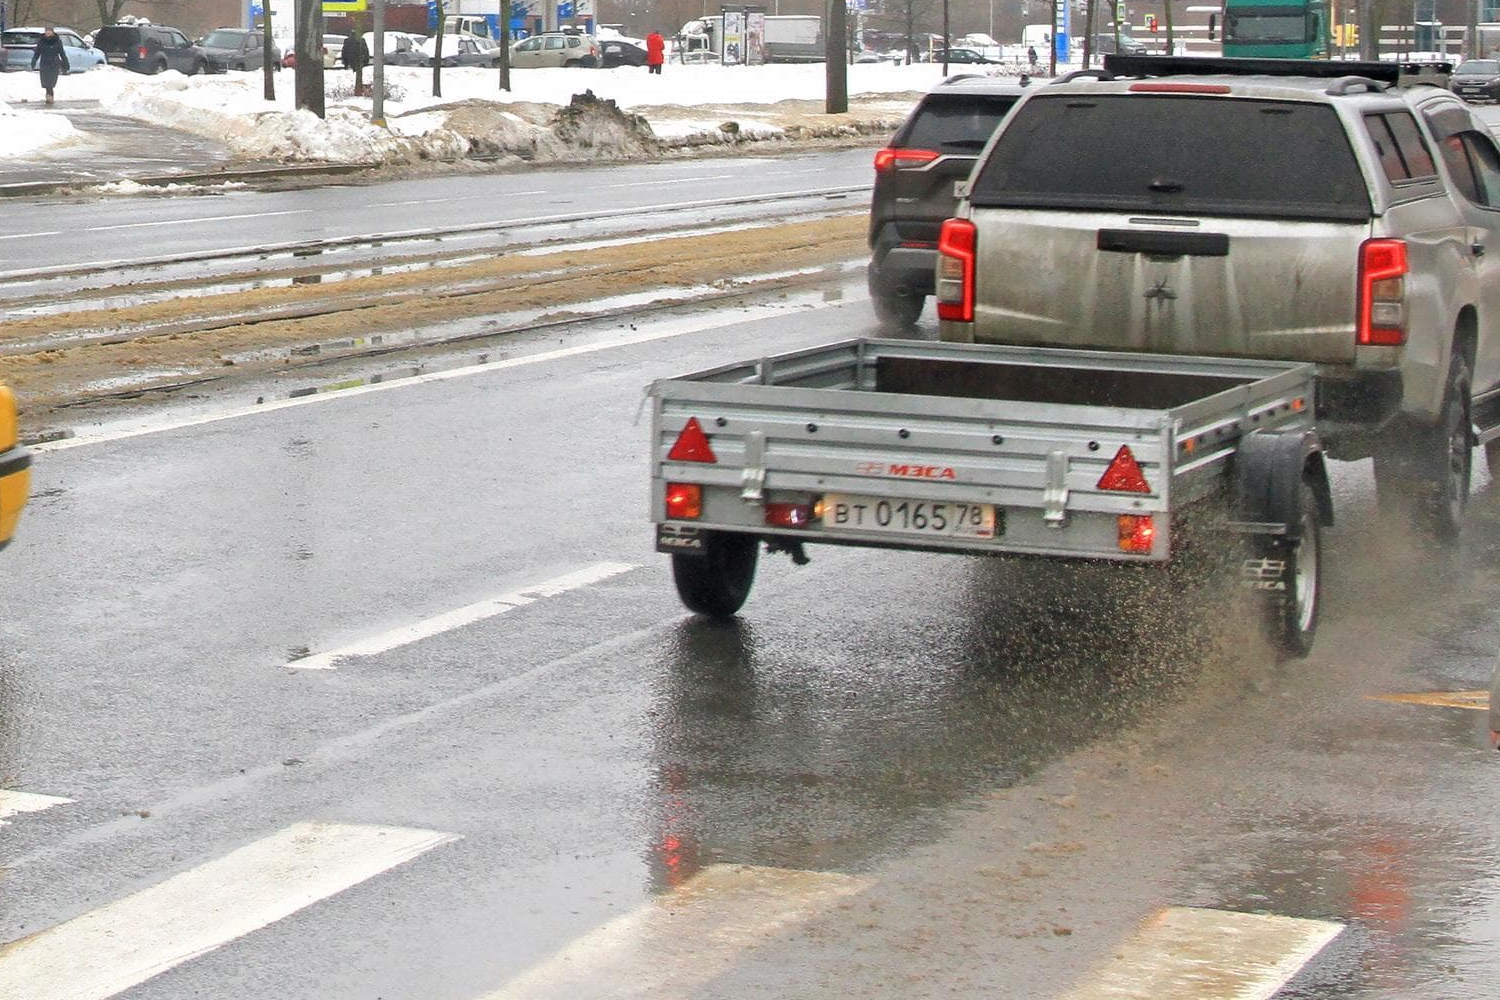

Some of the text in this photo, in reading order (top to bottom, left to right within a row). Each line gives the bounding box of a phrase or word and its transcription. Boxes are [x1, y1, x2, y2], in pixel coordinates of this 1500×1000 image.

[888, 463, 956, 479] МЗСА
[835, 500, 982, 530] ВТ 0165 78
